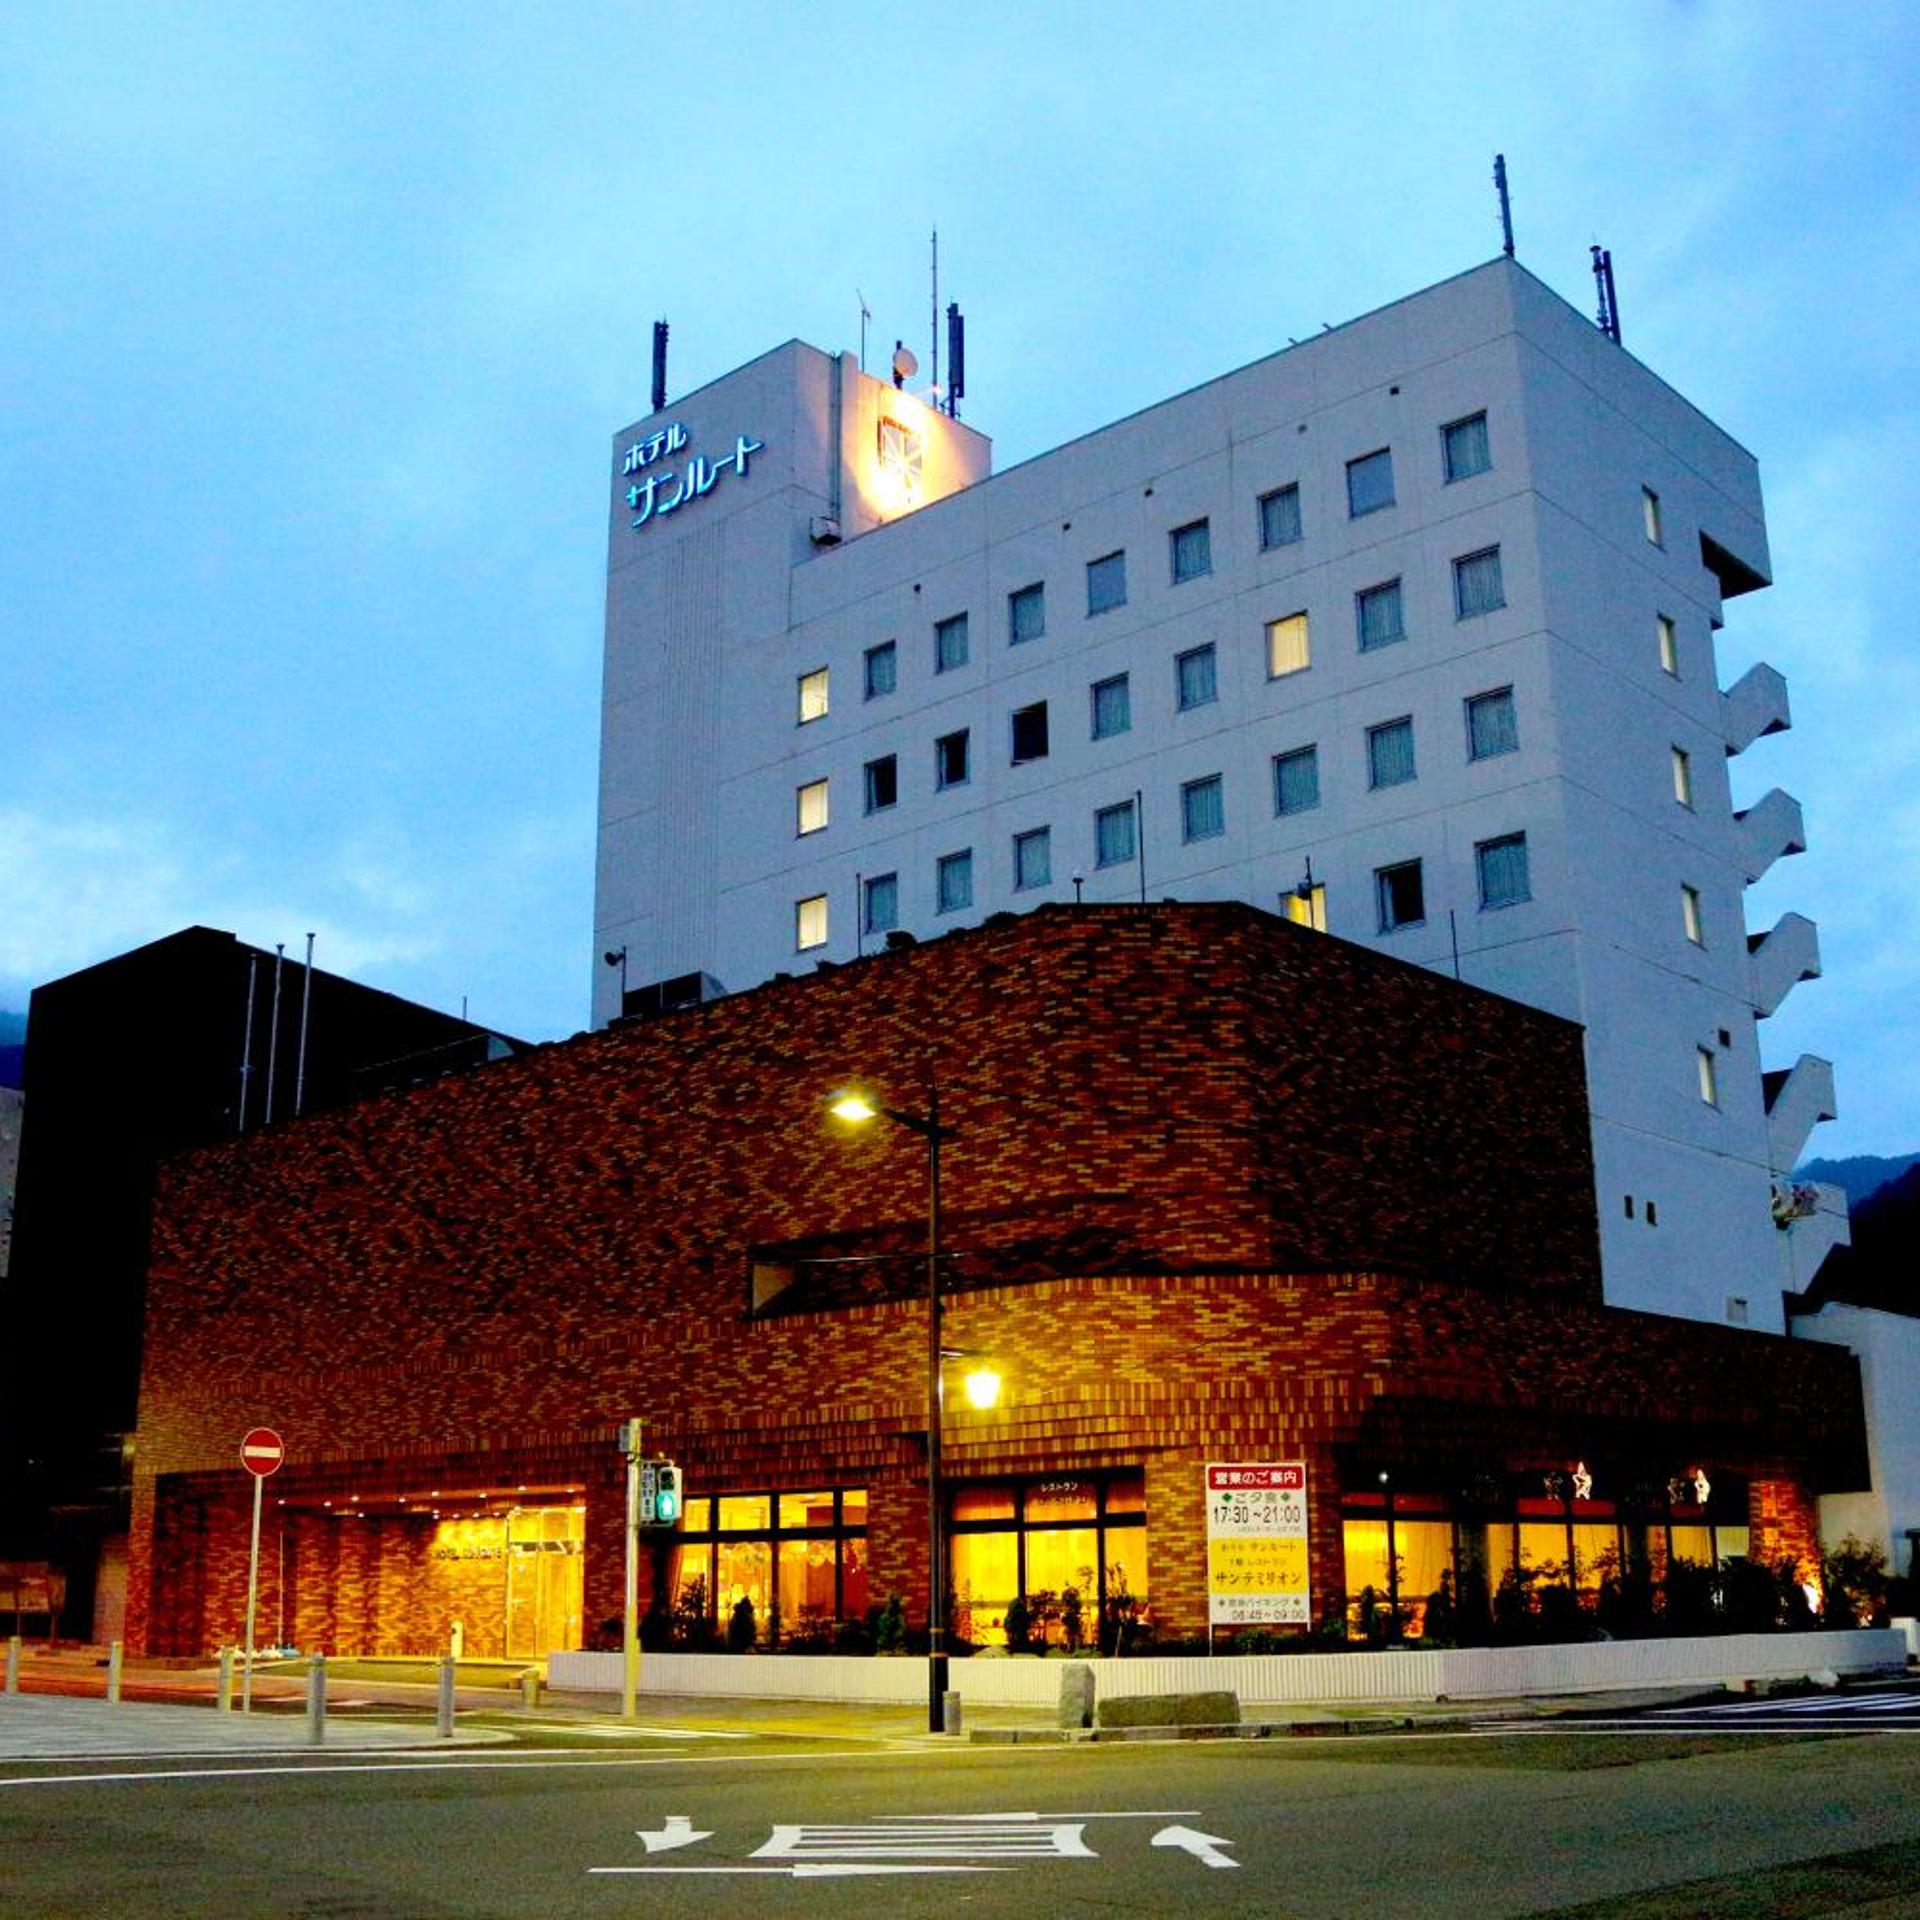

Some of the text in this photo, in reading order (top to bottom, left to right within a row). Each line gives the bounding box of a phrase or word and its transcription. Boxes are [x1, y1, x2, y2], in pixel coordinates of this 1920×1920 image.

[622, 423, 687, 475] ホテル
[626, 436, 763, 527] サンルート
[1215, 1471, 1297, 1485] 営業のご案内
